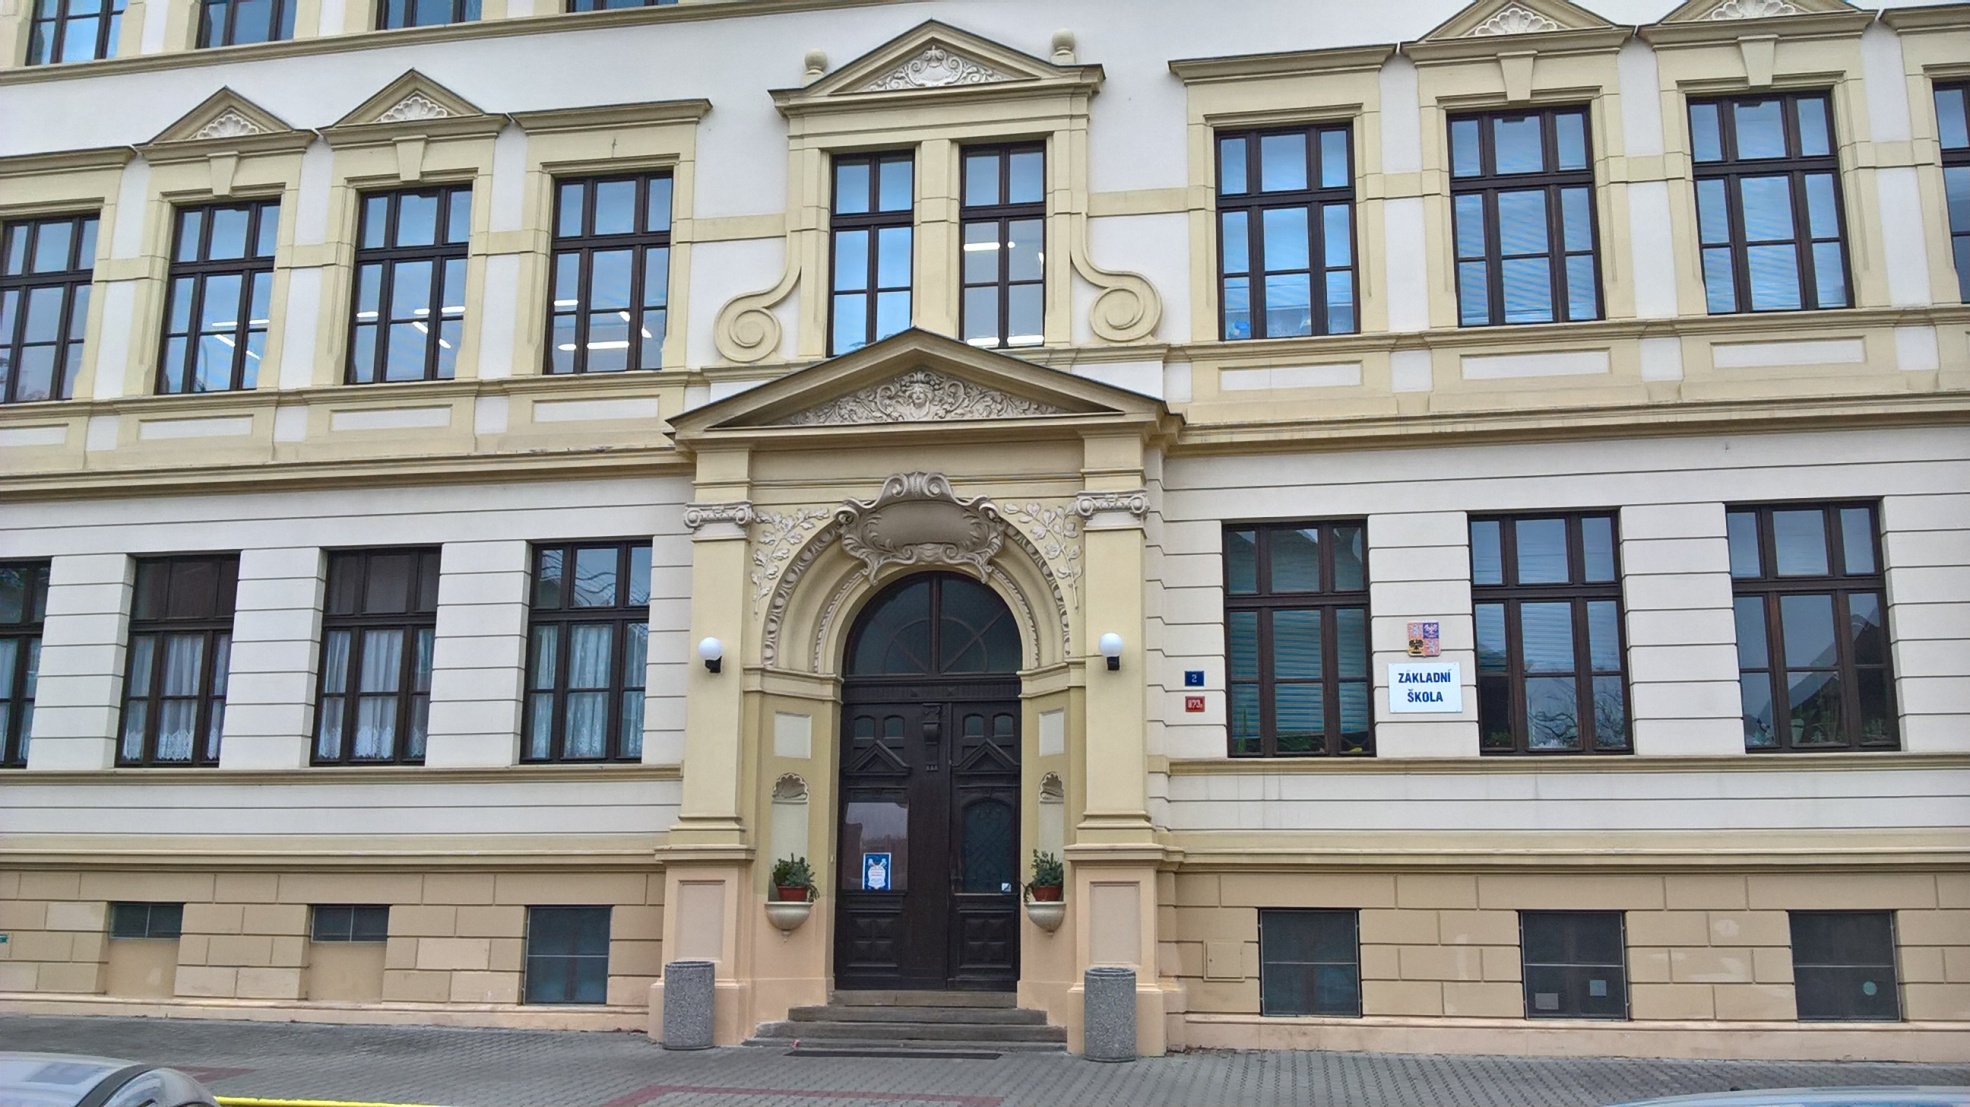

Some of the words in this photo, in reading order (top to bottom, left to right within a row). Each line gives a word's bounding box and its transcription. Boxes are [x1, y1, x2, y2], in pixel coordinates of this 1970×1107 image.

[1191, 674, 1198, 683] 2
[1398, 668, 1452, 683] ZÁKLADNÍ
[1407, 688, 1443, 703] ŠKOLA
